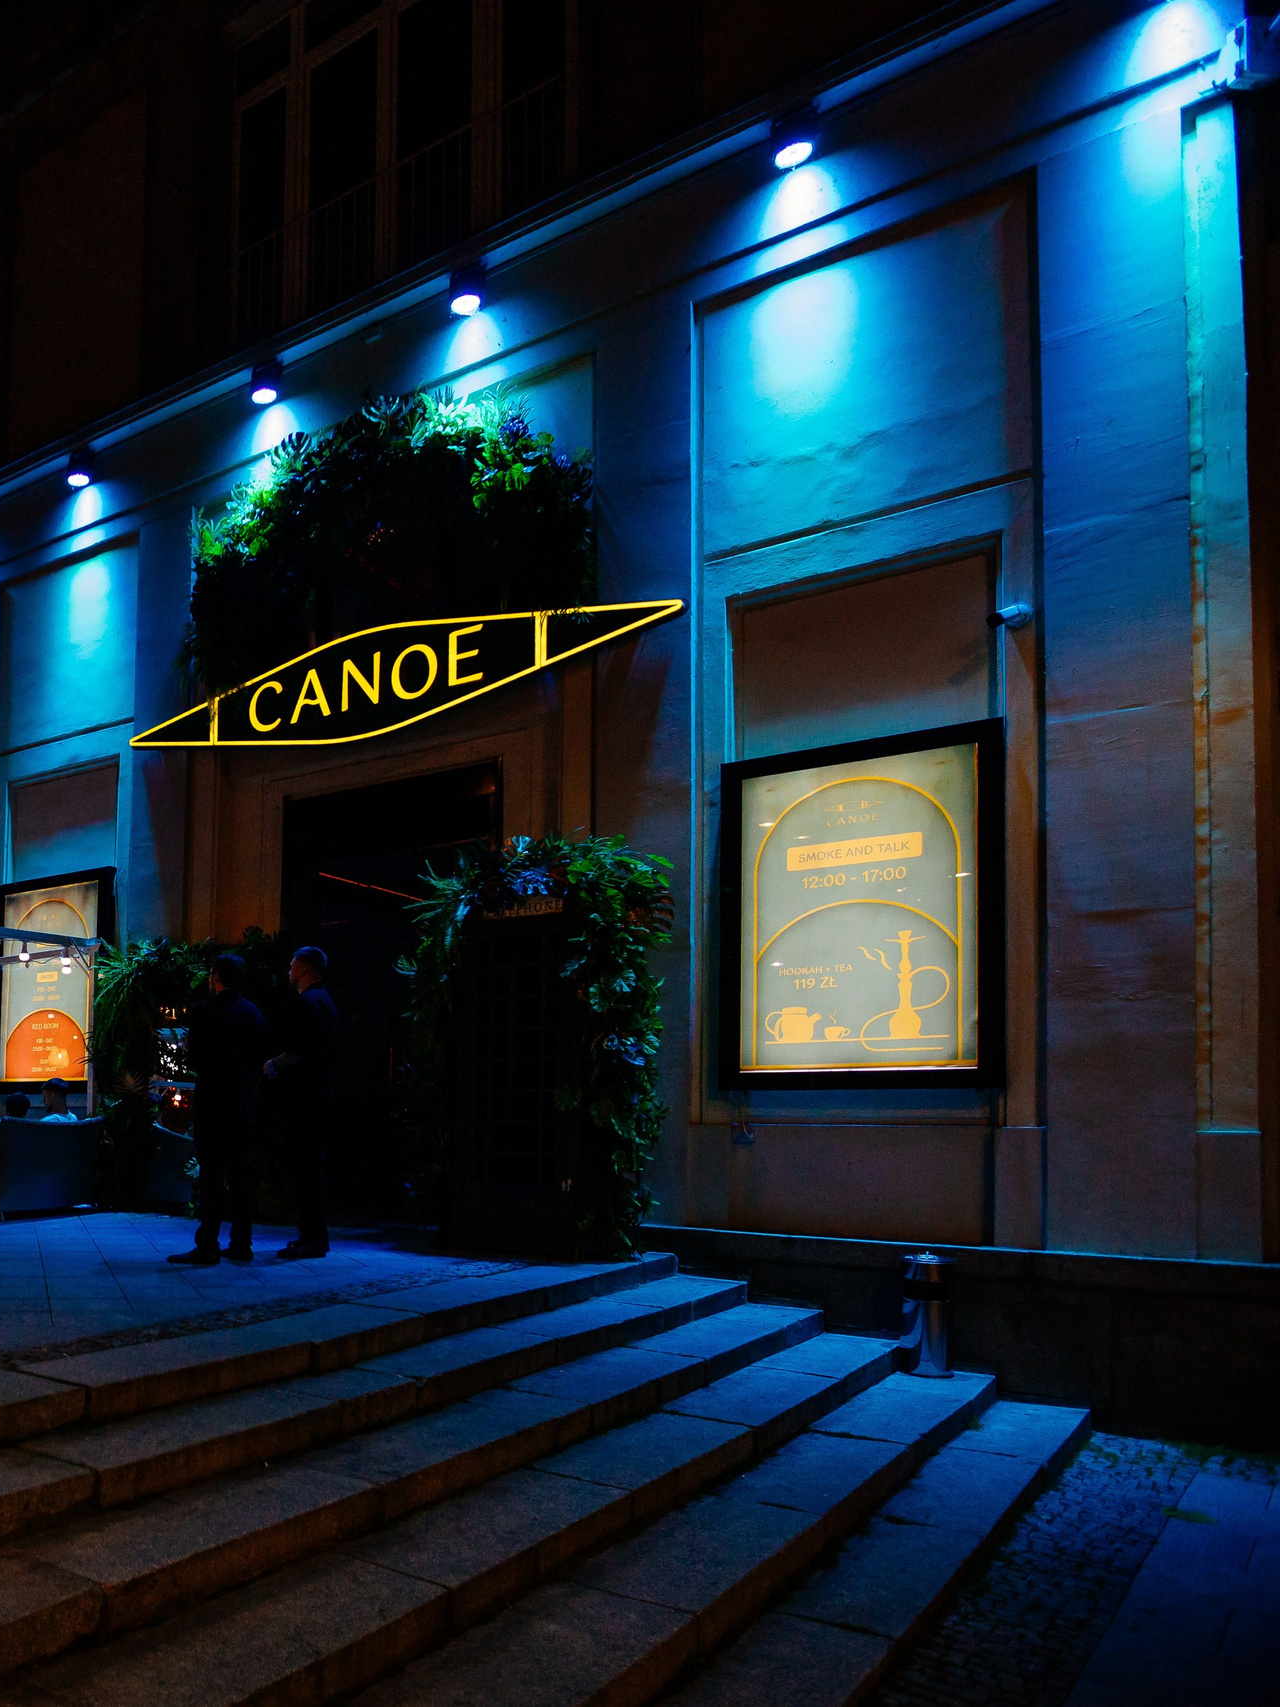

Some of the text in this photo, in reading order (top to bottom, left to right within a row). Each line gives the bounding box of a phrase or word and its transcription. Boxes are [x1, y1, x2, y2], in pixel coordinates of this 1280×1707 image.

[248, 623, 484, 732] CANOE
[826, 813, 878, 828] CANOE
[798, 841, 910, 863] SMOKE AND TALK
[801, 873, 846, 889] 12:00
[862, 866, 907, 883] 17:00
[779, 966, 823, 976] HOOKAH
[834, 964, 853, 972] TEA
[793, 976, 838, 990] 119 ZŁ
[43, 1022, 59, 1030] ROOM
